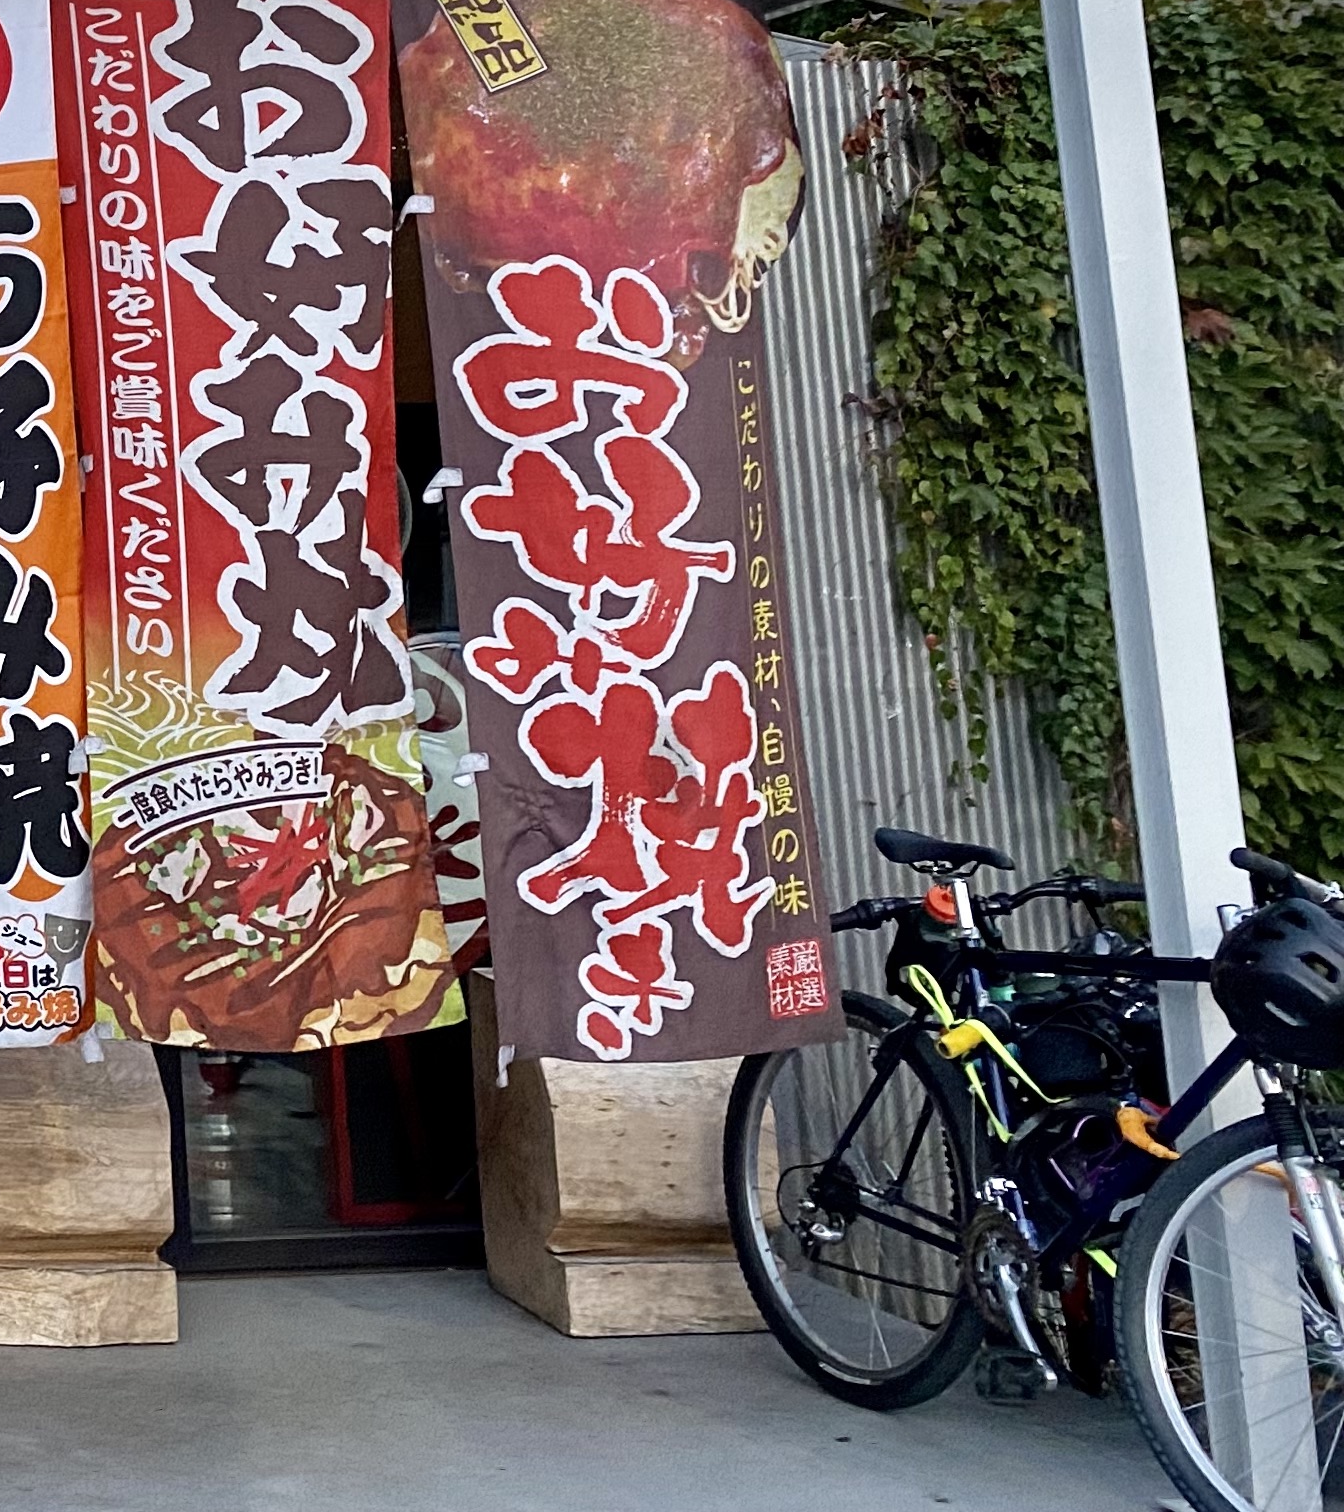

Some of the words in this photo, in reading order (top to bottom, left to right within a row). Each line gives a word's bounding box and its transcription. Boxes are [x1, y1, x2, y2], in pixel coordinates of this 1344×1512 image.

[83, 5, 173, 658] こだわりの味をご賞味ください
[736, 359, 810, 917] こだわりの素材、自慢の味
